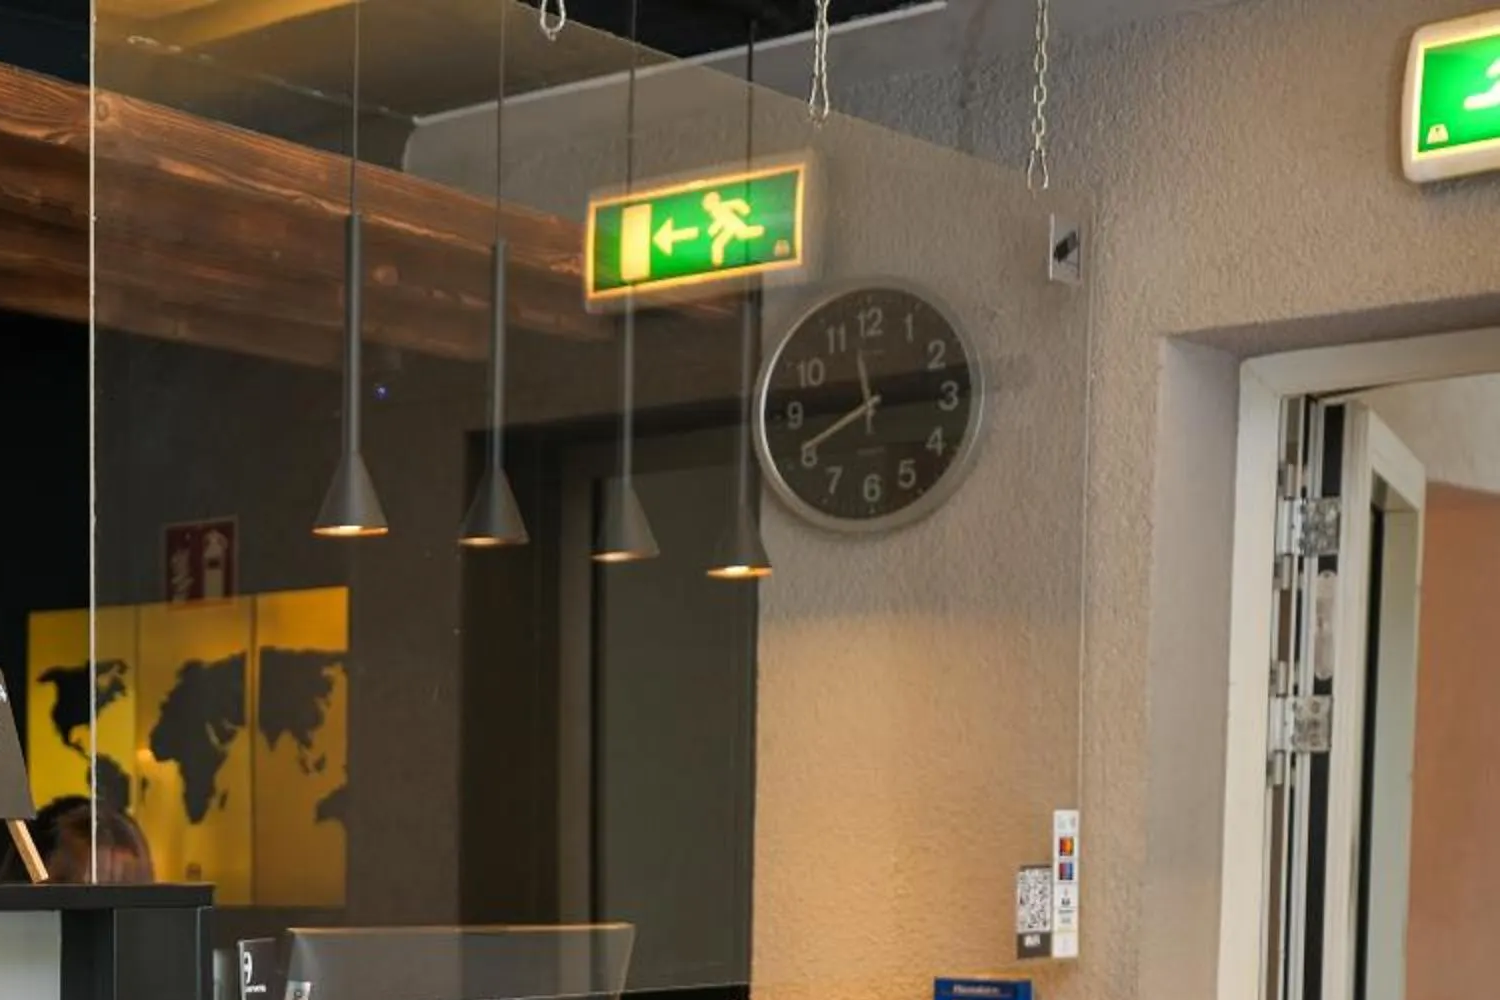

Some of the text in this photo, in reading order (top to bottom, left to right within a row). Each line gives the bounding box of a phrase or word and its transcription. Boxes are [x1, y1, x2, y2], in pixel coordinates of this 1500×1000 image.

[857, 306, 884, 338] 12
[904, 312, 914, 342] 1
[826, 325, 846, 354] 11
[927, 340, 946, 370] 2
[797, 358, 825, 387] 10
[938, 381, 959, 411] 3
[787, 402, 804, 430] 9
[802, 442, 818, 467] 8
[926, 427, 947, 456] 4
[826, 466, 843, 494] 7
[863, 474, 882, 502] 6
[898, 459, 916, 488] 5
